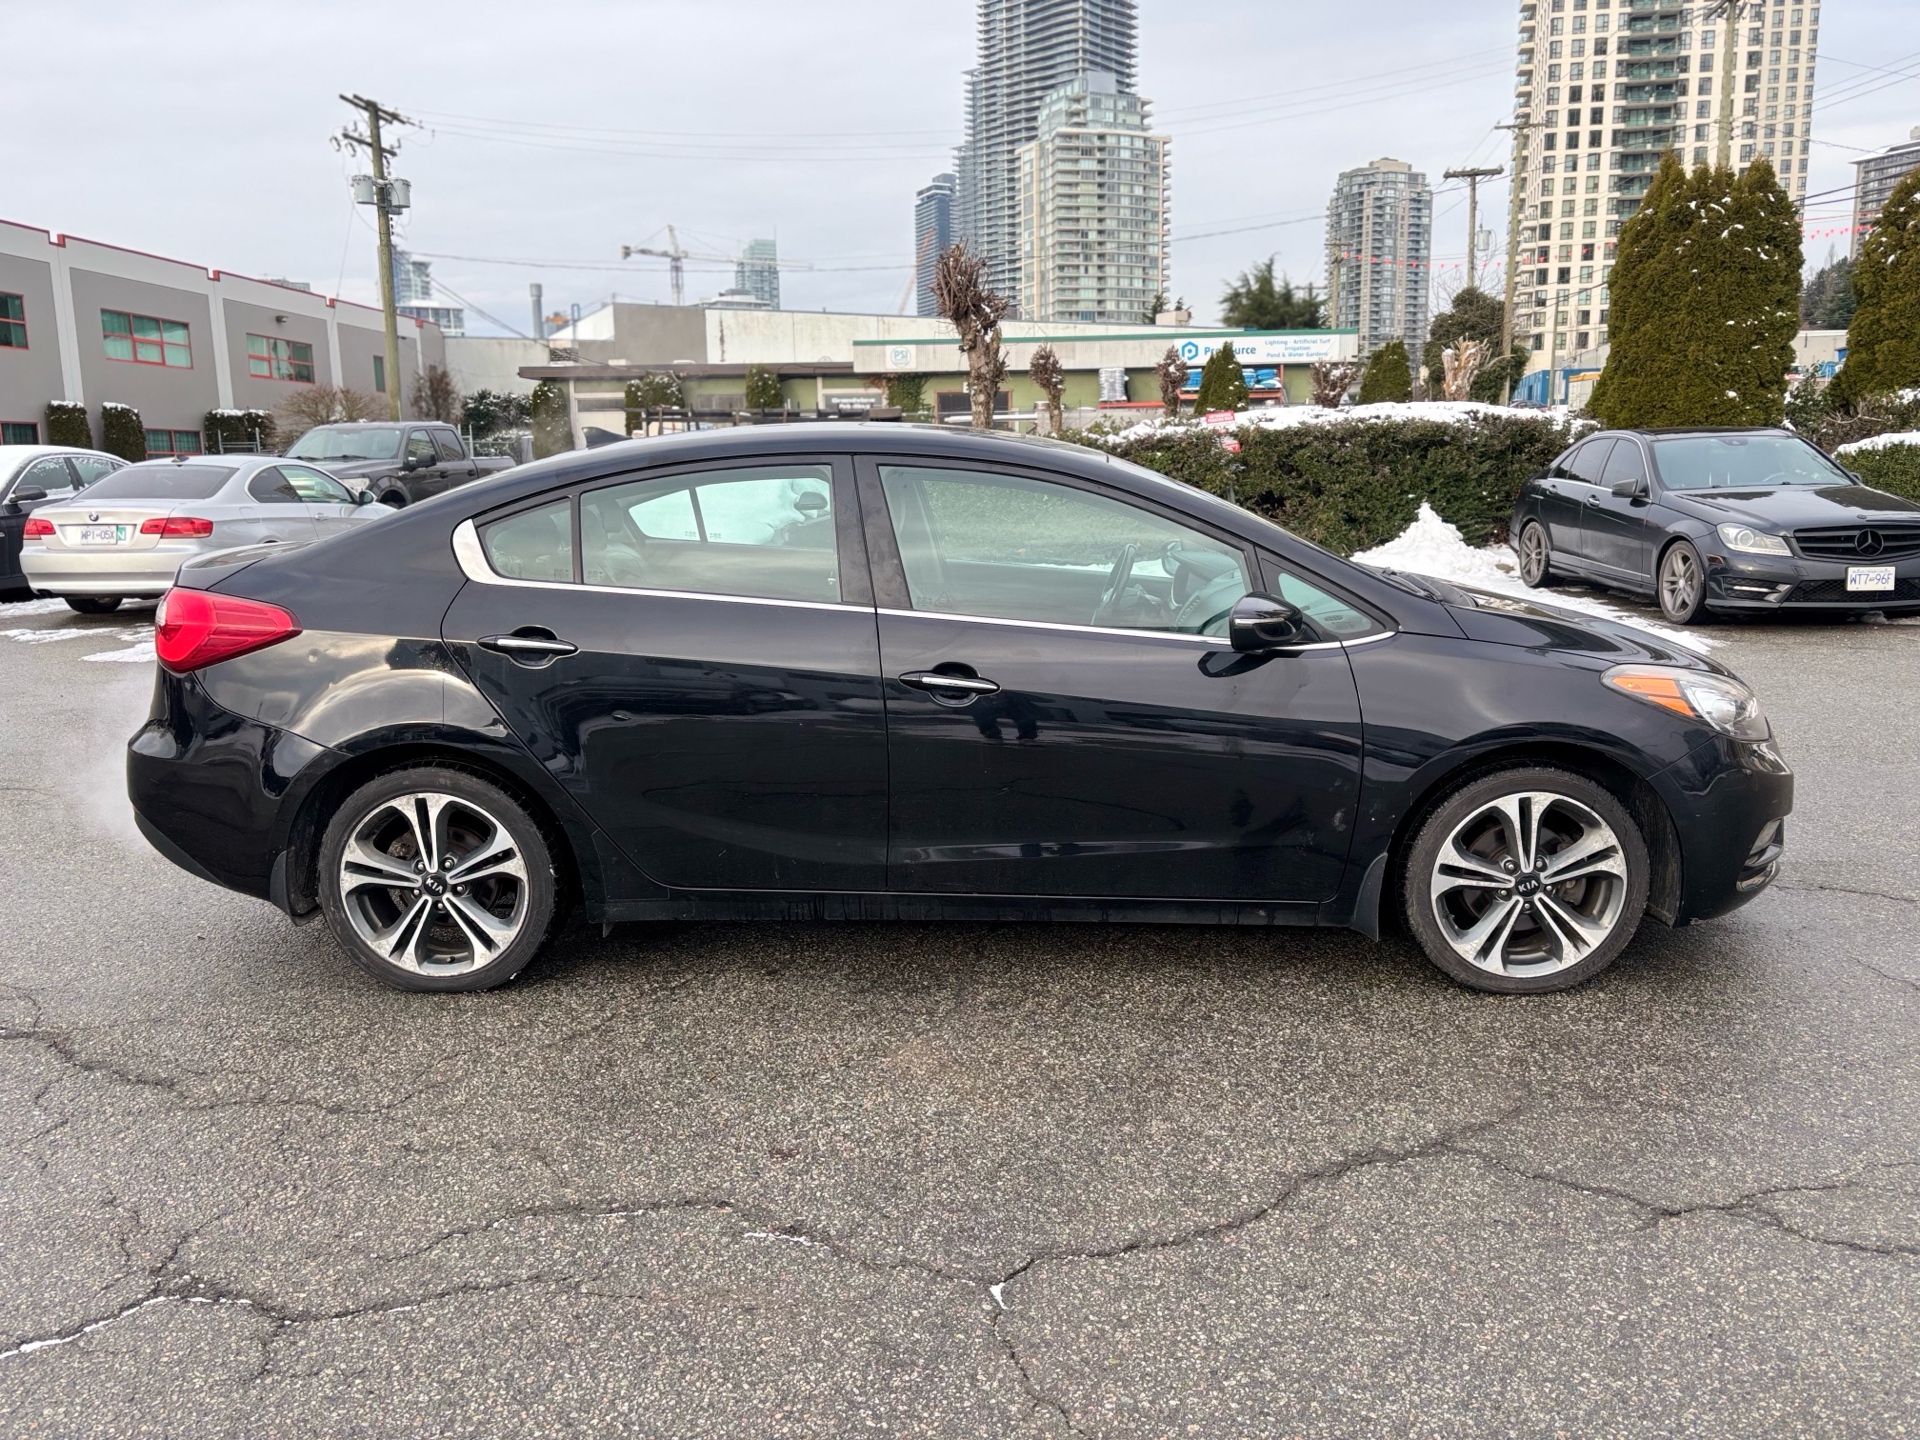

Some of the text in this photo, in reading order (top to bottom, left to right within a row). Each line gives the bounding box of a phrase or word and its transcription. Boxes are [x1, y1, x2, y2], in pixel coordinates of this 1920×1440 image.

[894, 350, 908, 359] PSI
[426, 877, 444, 894] KIA
[1518, 879, 1539, 893] KIA
